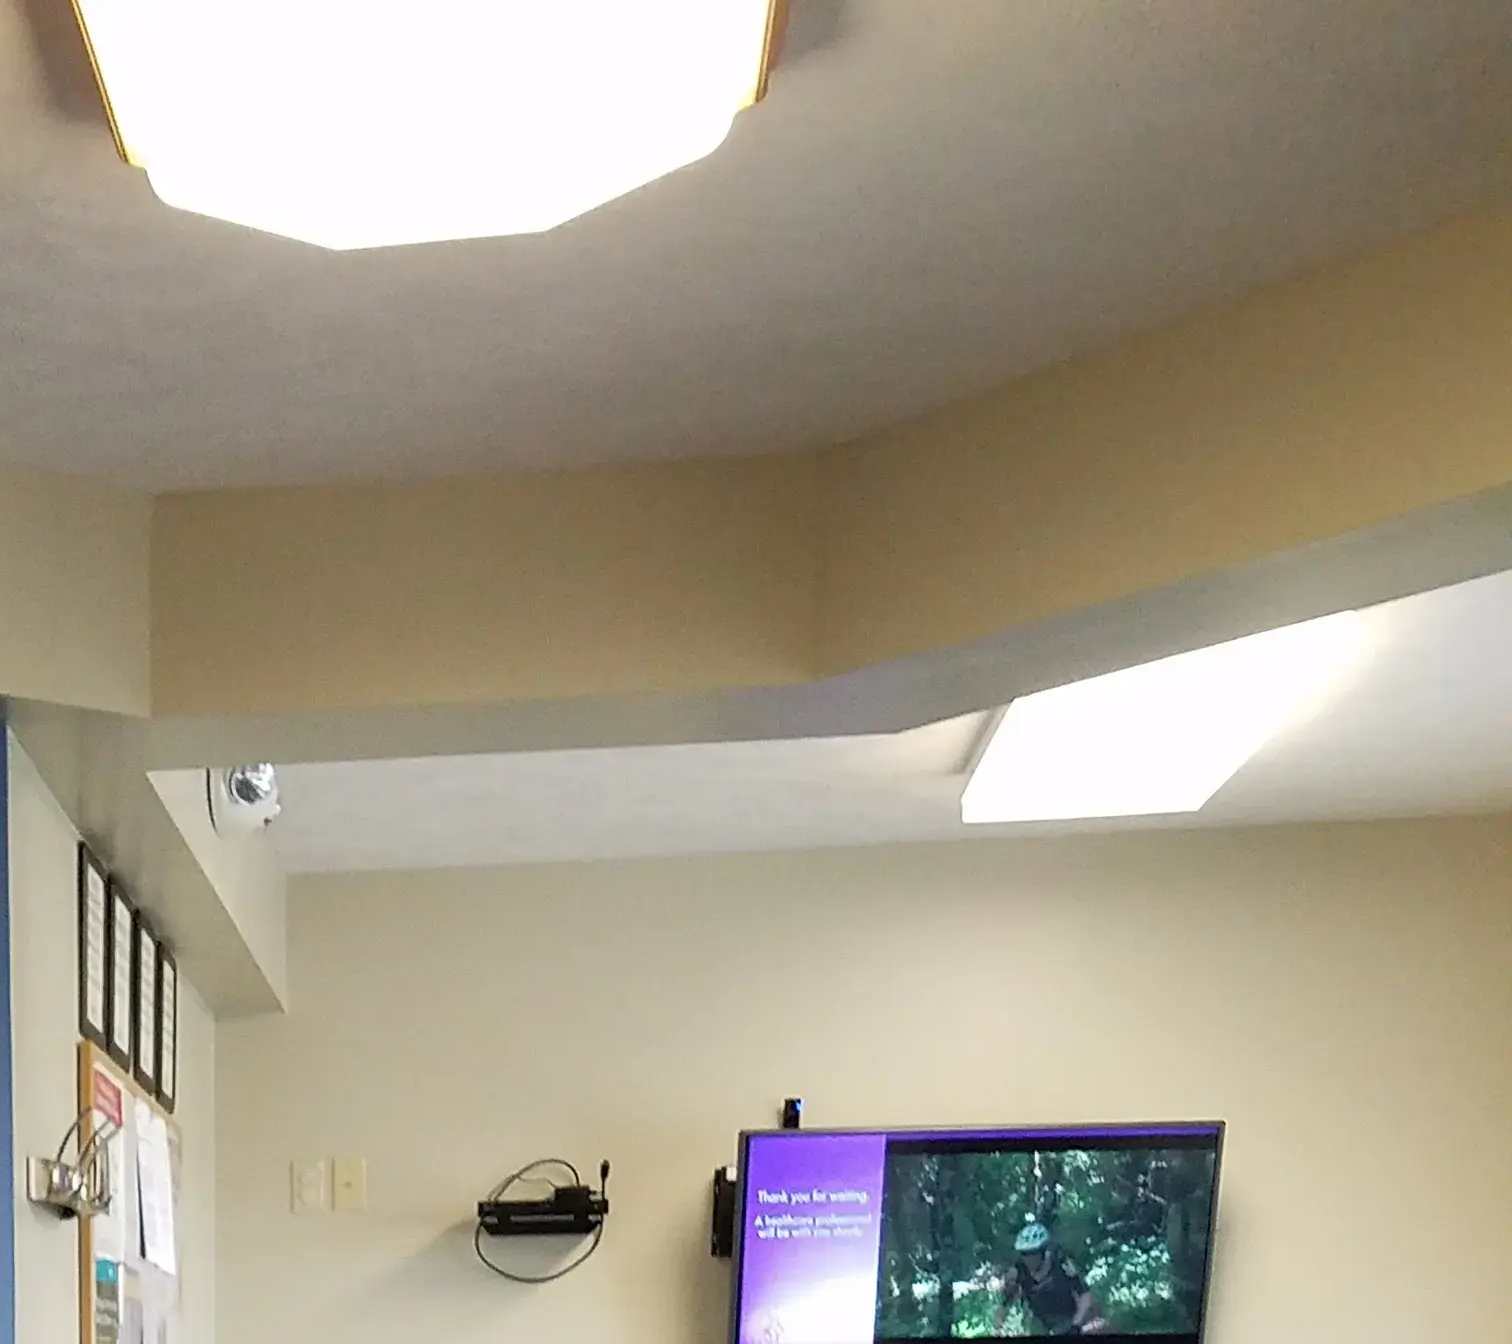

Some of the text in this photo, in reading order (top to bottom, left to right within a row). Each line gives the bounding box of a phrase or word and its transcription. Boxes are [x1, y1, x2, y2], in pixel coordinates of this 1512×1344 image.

[757, 1189, 788, 1204] Thank
[790, 1192, 810, 1206] you
[812, 1189, 827, 1203] for
[754, 1215, 764, 1227] A
[757, 1227, 775, 1239] will
[776, 1227, 789, 1238] be
